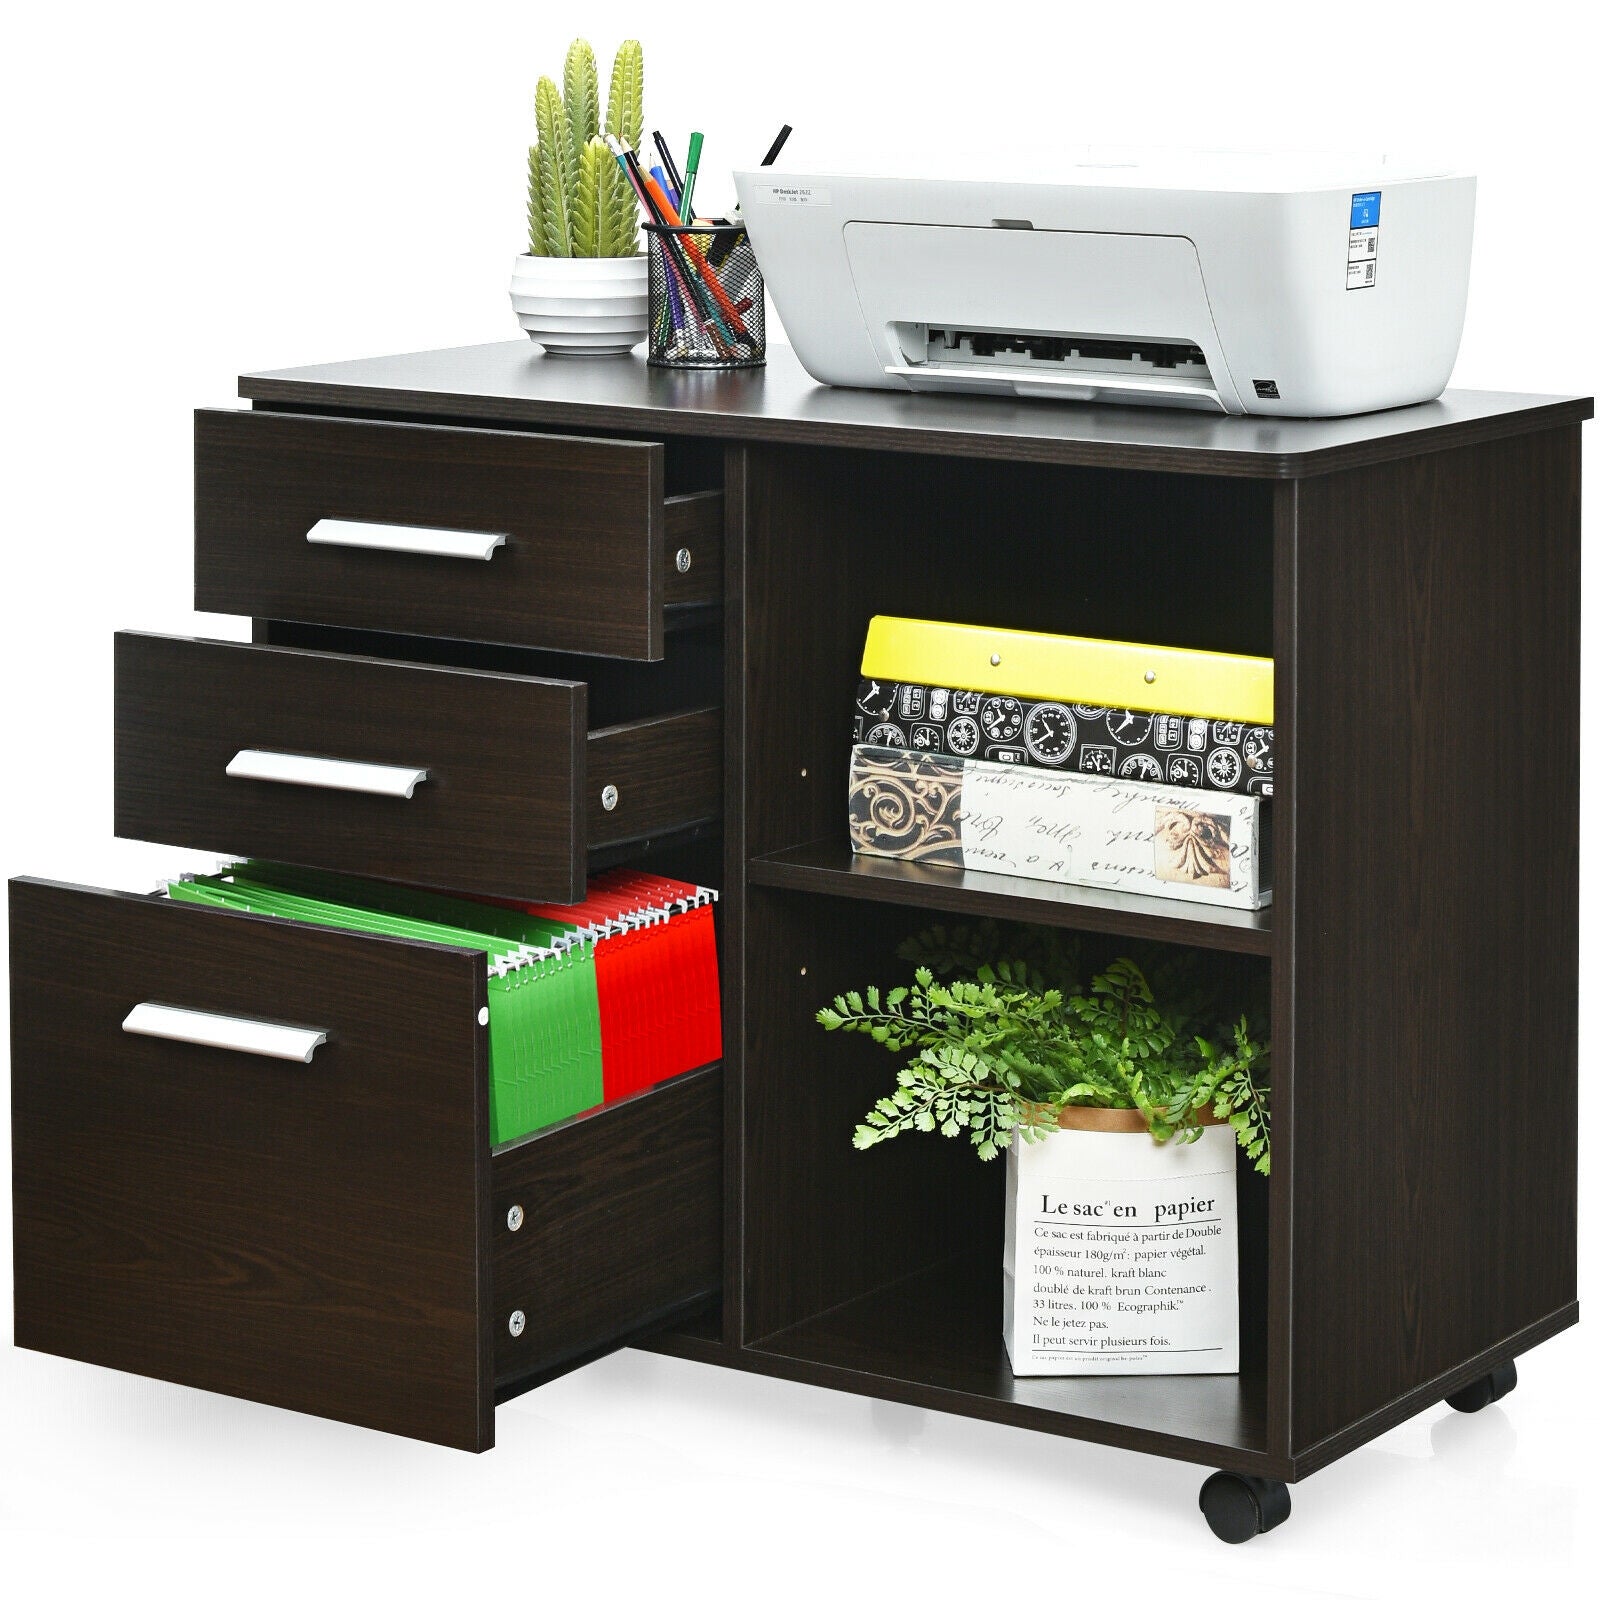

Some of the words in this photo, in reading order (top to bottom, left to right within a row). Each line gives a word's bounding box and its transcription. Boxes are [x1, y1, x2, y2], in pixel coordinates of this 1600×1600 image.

[1041, 1195, 1068, 1214] Le
[1114, 1206, 1137, 1217] en
[1155, 1197, 1215, 1223] papier
[1035, 1227, 1048, 1237] Ce
[1051, 1231, 1067, 1239] sac
[1070, 1232, 1084, 1240] est
[1087, 1231, 1130, 1244] fabriqué
[1133, 1233, 1138, 1241] à
[1142, 1231, 1170, 1244] partir
[1172, 1229, 1184, 1239] de
[1185, 1224, 1221, 1238] Double
[1034, 1246, 1082, 1258] épaisseur
[1135, 1250, 1167, 1262] papier
[1170, 1245, 1206, 1260] végétal.
[1034, 1265, 1051, 1274] 100
[1054, 1266, 1064, 1275] %
[1112, 1268, 1135, 1277] kraft
[1139, 1268, 1167, 1277] blanc
[1034, 1283, 1069, 1294] doublé
[1073, 1285, 1085, 1294] de
[1088, 1285, 1112, 1295] kraft
[1116, 1286, 1140, 1295] brun
[1033, 1299, 1045, 1308] 33
[1082, 1301, 1098, 1311] 100
[1102, 1302, 1111, 1310] %
[1033, 1316, 1048, 1326] Ne
[1052, 1317, 1060, 1326] le
[1062, 1318, 1086, 1330] jetez
[1089, 1321, 1108, 1331] pas.
[1034, 1334, 1039, 1343] Il
[1043, 1337, 1066, 1347] peut
[1069, 1337, 1098, 1346] servir
[1101, 1337, 1147, 1349] plusieurs
[1150, 1336, 1170, 1345] fois.
